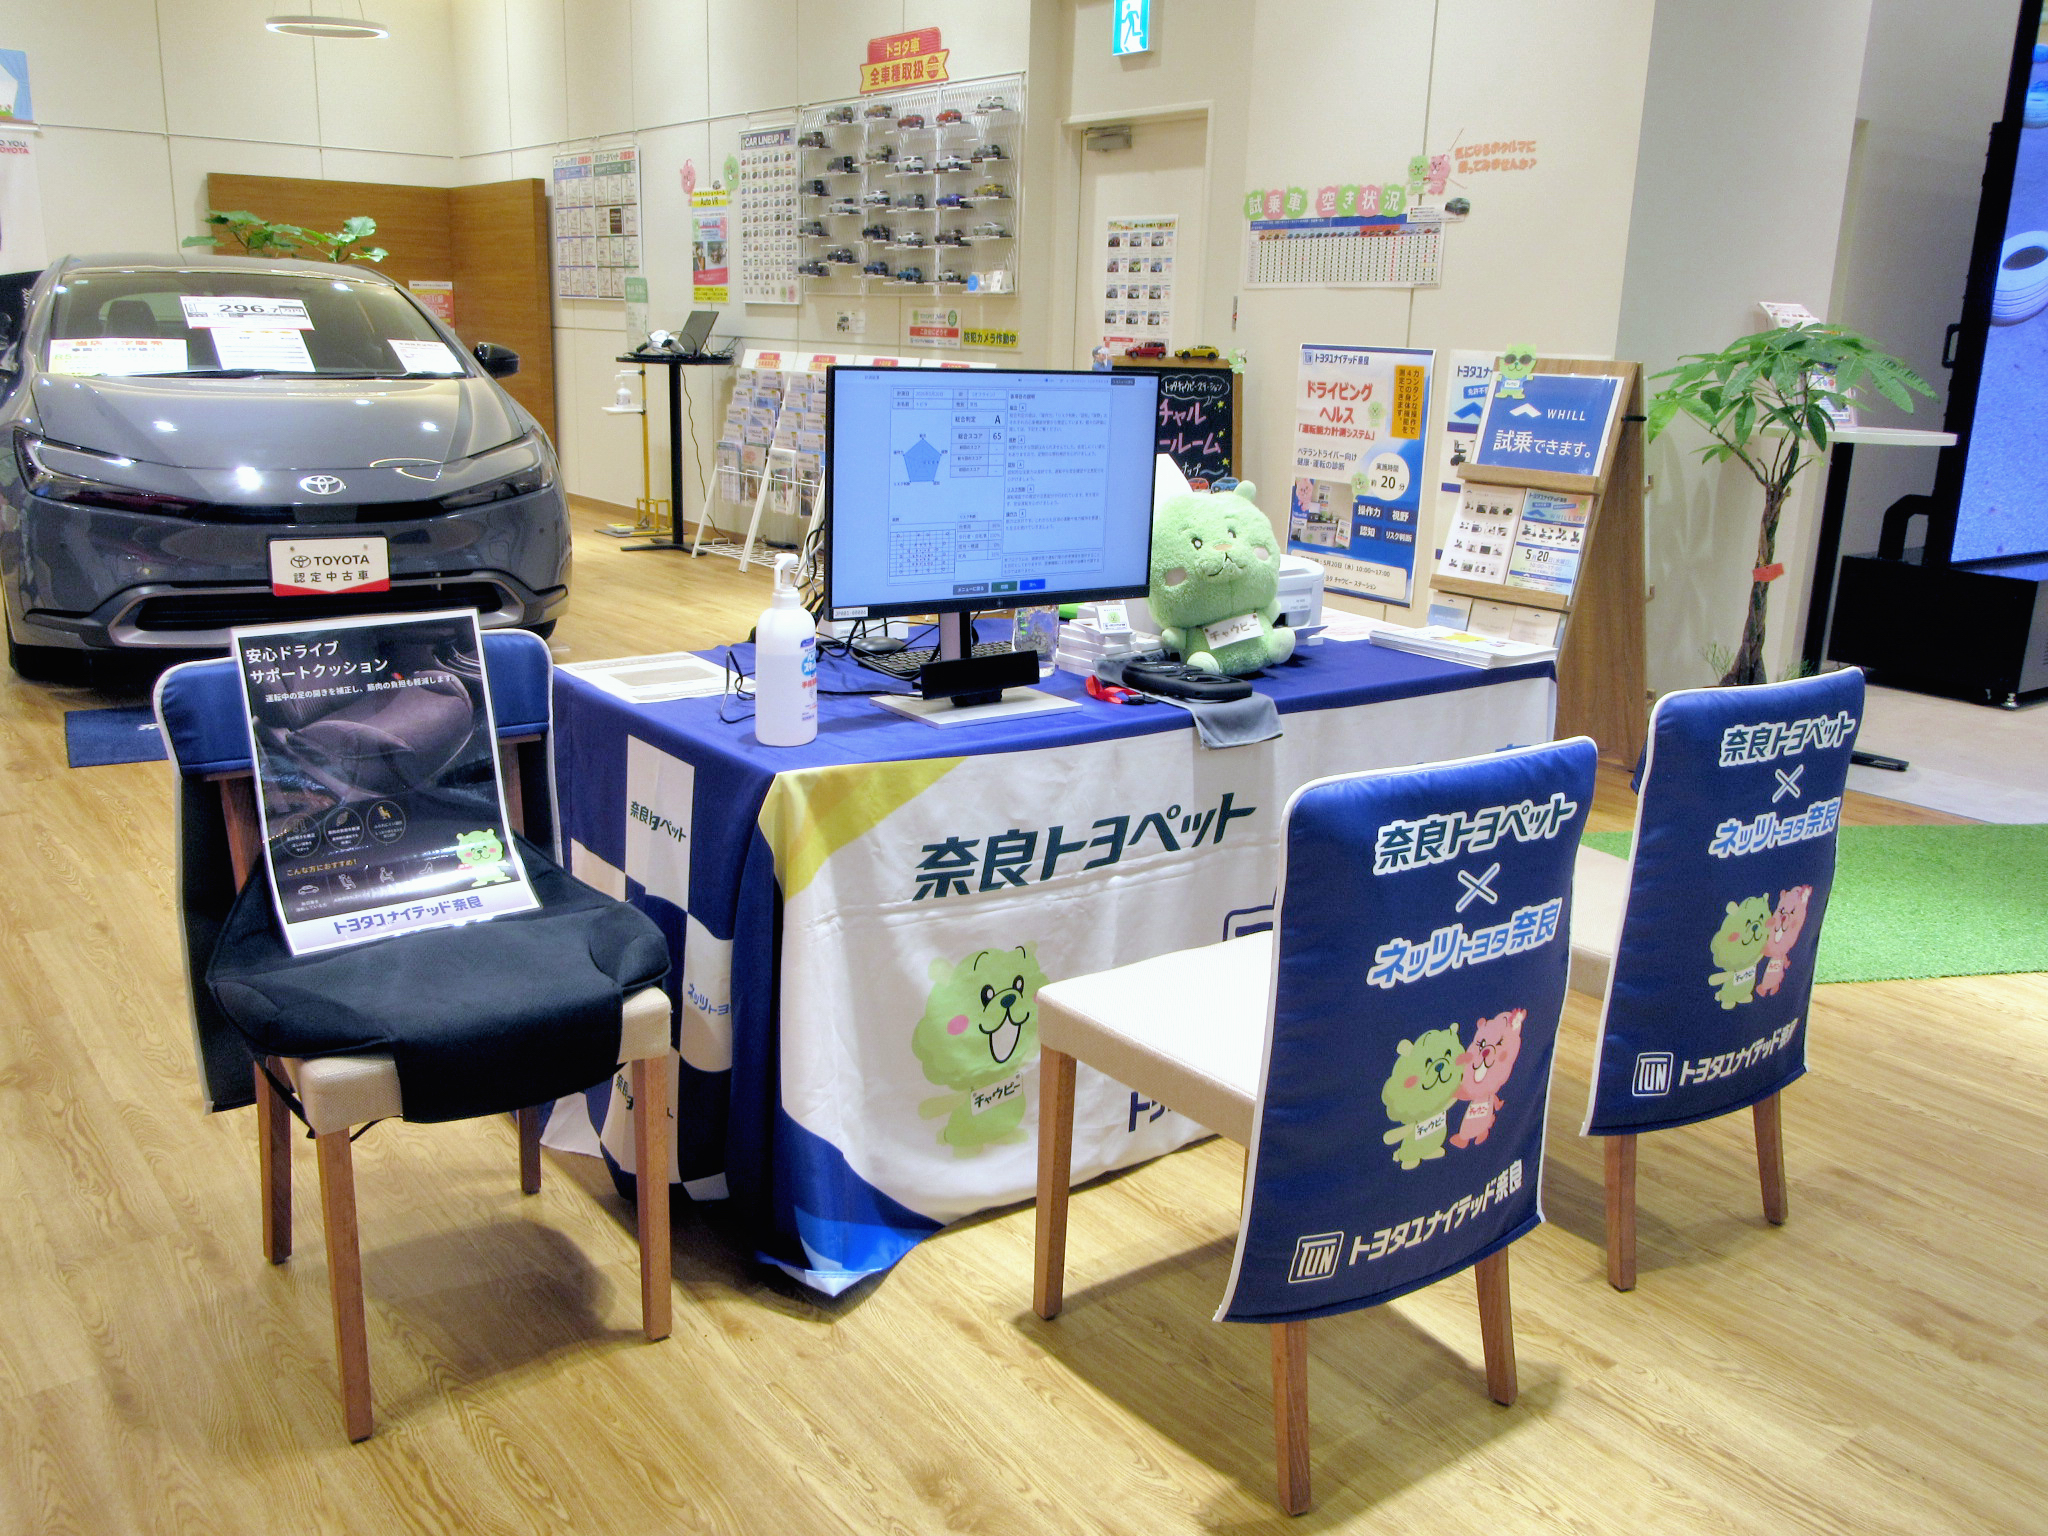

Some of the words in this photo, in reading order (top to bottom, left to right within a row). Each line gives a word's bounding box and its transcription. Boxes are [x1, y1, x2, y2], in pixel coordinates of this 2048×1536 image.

[886, 37, 920, 58] トヨタ車
[870, 60, 924, 86] 全車種取扱
[745, 136, 757, 146] CAR
[758, 133, 780, 146] LINEUP
[1249, 192, 1302, 216] 試乗車
[1321, 190, 1401, 212] 空き状況
[963, 331, 1017, 345] 防犯カメラ作動中
[1307, 380, 1373, 402] ドライビング
[1410, 369, 1420, 435] カンタンな操作で
[994, 415, 1001, 424] A
[1320, 406, 1354, 424] ヘルス
[1547, 408, 1586, 421] WHILL
[992, 432, 1002, 440] 65
[1298, 423, 1375, 441] 「運転能力計測システム」
[1297, 447, 1357, 461] ベテランドライバー向け
[1493, 430, 1591, 459] 試乗できます。
[1381, 476, 1396, 489] 20
[1399, 483, 1405, 491] 分
[1358, 505, 1381, 518] 操作力
[1392, 510, 1409, 522] 視野
[1360, 525, 1376, 537] 認知
[1386, 530, 1412, 543] リスク判断
[314, 555, 370, 566] TOYOTA
[294, 570, 369, 584] 認定中古車
[245, 640, 338, 664] 安心ドライブ
[249, 658, 388, 685] サポートクッション
[1718, 710, 1857, 767] 奈良トヨペット
[1373, 792, 1578, 876] 奈良トヨペット
[1708, 796, 1841, 859] ネッツトヨタ奈良
[912, 792, 1257, 902] 奈良トヨペット
[1366, 897, 1563, 989] ネッツトヨタ奈良
[1678, 1018, 1799, 1087] トヨタユナイテッド奈良
[1638, 1057, 1668, 1091] TUN
[974, 1083, 1021, 1108] チャウピー
[1416, 1117, 1445, 1135] チャウピー
[1348, 1158, 1523, 1266] トヨタユナイテッド奈良
[1296, 1238, 1338, 1278] TUN
